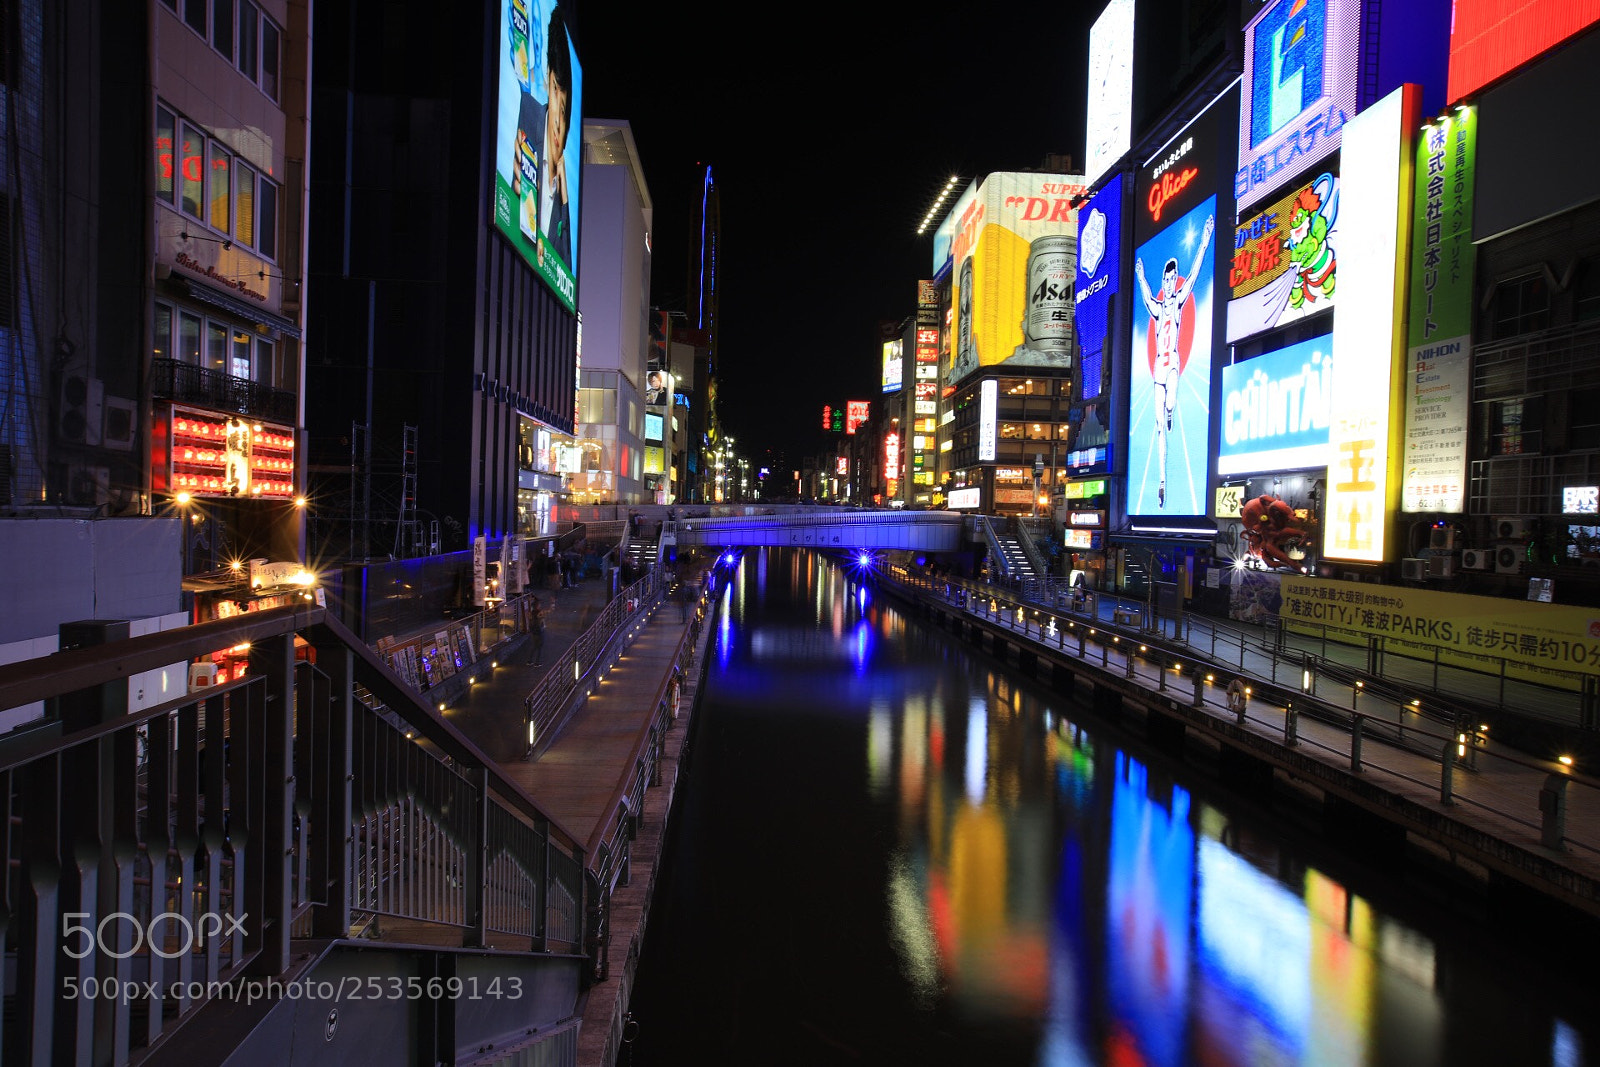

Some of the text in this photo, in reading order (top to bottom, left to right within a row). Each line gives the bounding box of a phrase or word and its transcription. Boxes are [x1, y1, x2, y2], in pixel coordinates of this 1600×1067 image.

[1234, 104, 1347, 199] 日商エステム
[1148, 167, 1198, 220] Glico
[1450, 116, 1468, 284] 不動産再生のスペシャリスト
[1235, 213, 1277, 249] かぜに
[1423, 128, 1446, 339] 株式会社日本リート
[1229, 232, 1281, 288] 改源
[1051, 310, 1068, 321] 生
[1416, 342, 1461, 361] NIHON
[1416, 361, 1436, 373] Real
[1416, 373, 1441, 384] Estate
[1415, 383, 1451, 395] Investment
[1414, 395, 1452, 406] Technology
[1414, 404, 1442, 414] SERVICE
[1414, 412, 1447, 422] PROVIDER
[1334, 439, 1377, 551] 玉出
[1564, 487, 1599, 505] BAR
